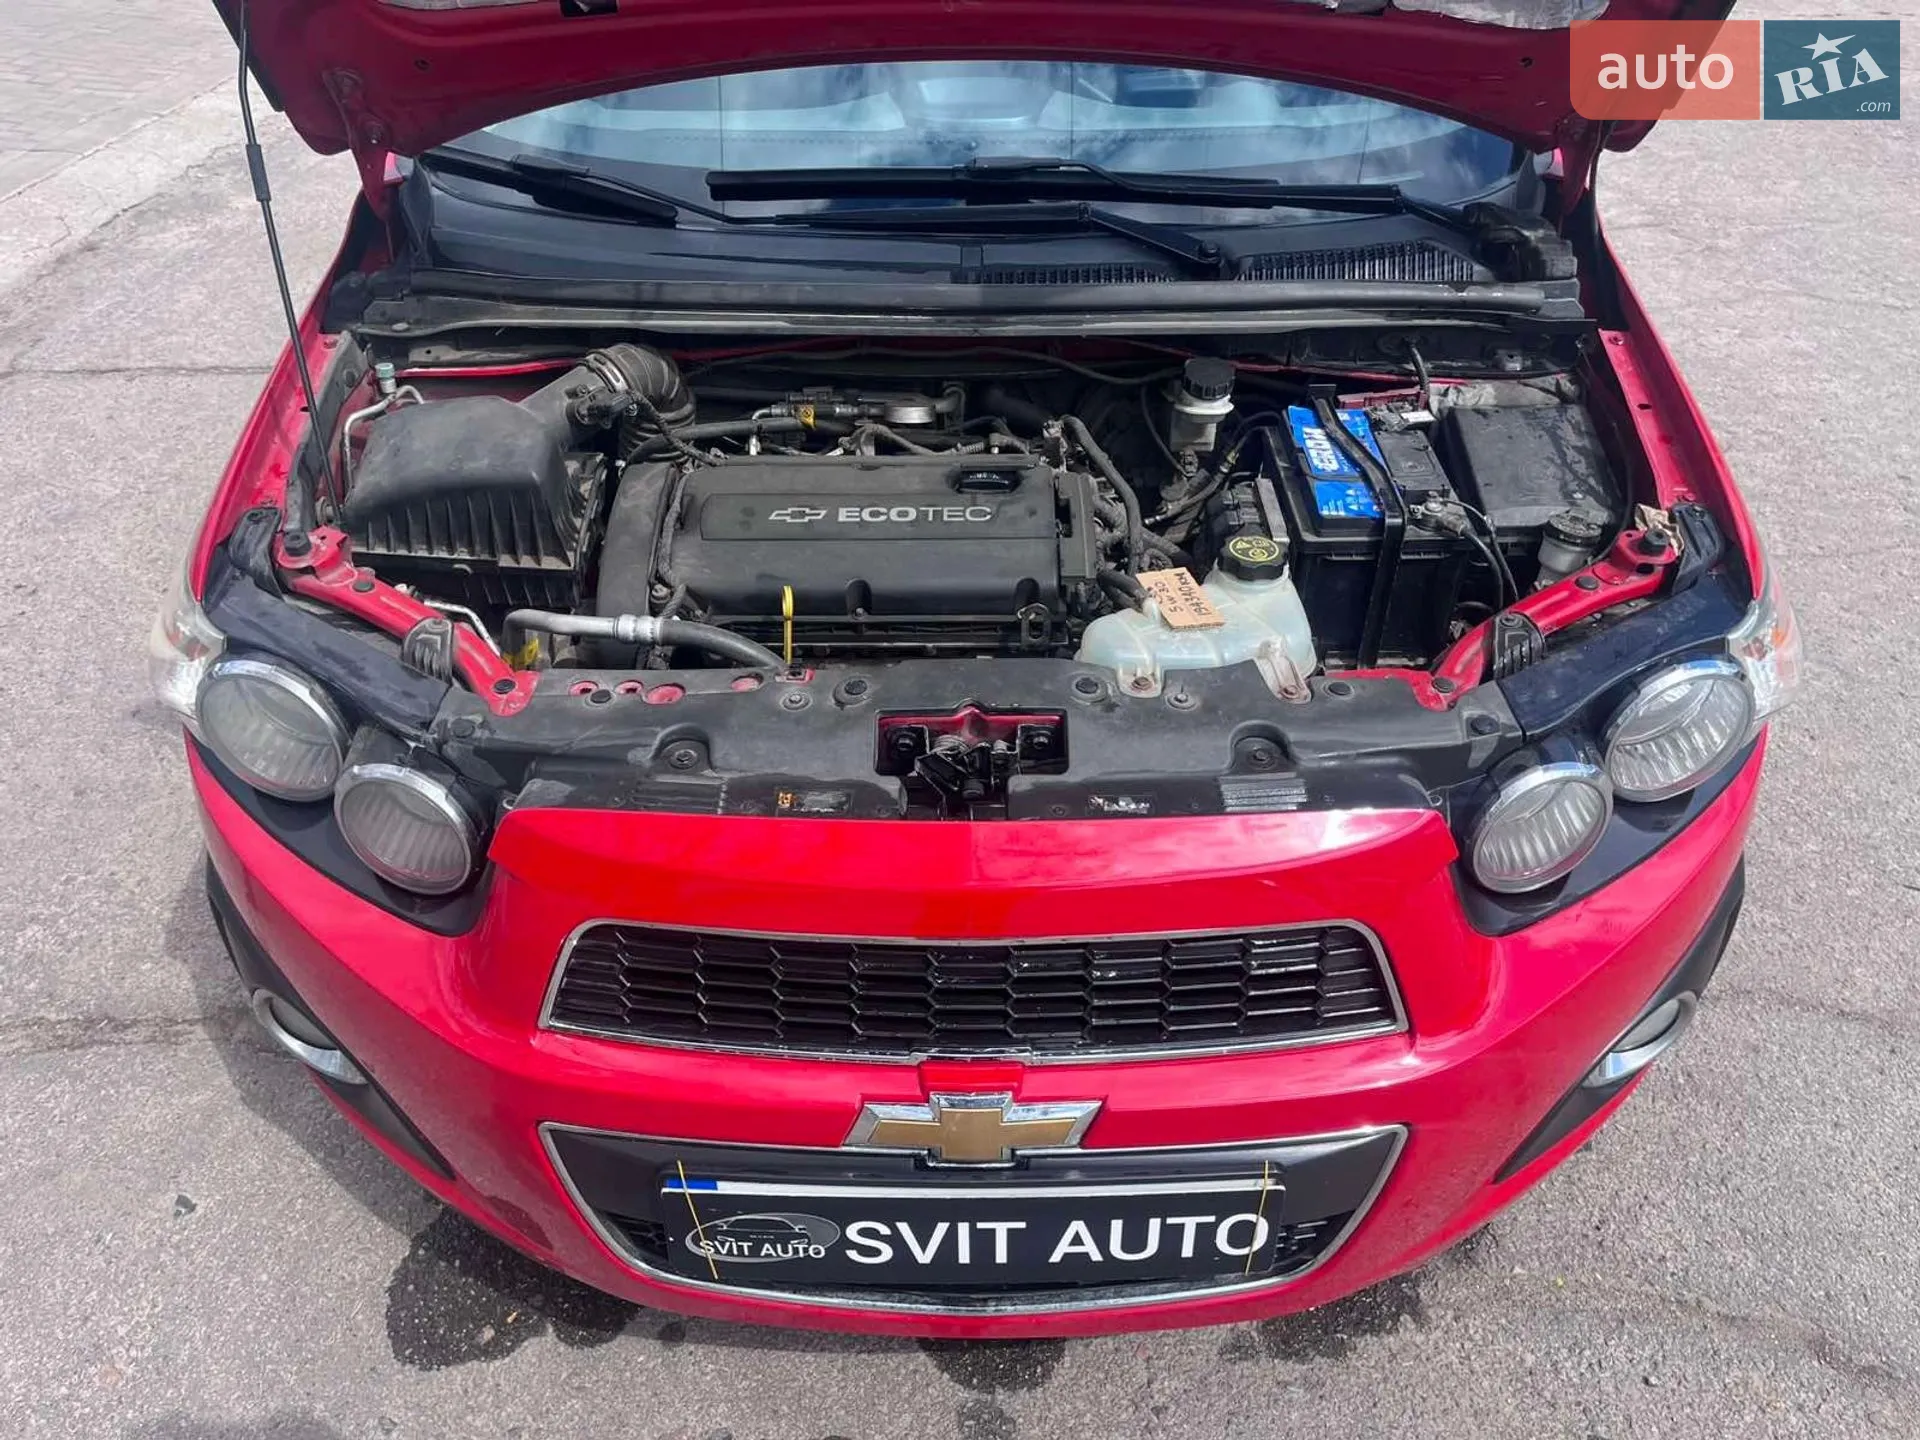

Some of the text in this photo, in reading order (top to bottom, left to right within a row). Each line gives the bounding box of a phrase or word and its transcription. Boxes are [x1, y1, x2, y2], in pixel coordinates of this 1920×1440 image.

[837, 507, 992, 522] ECOTEC
[845, 1213, 1270, 1265] SVIT AUTO
[699, 1240, 826, 1259] SVIT AUTO
